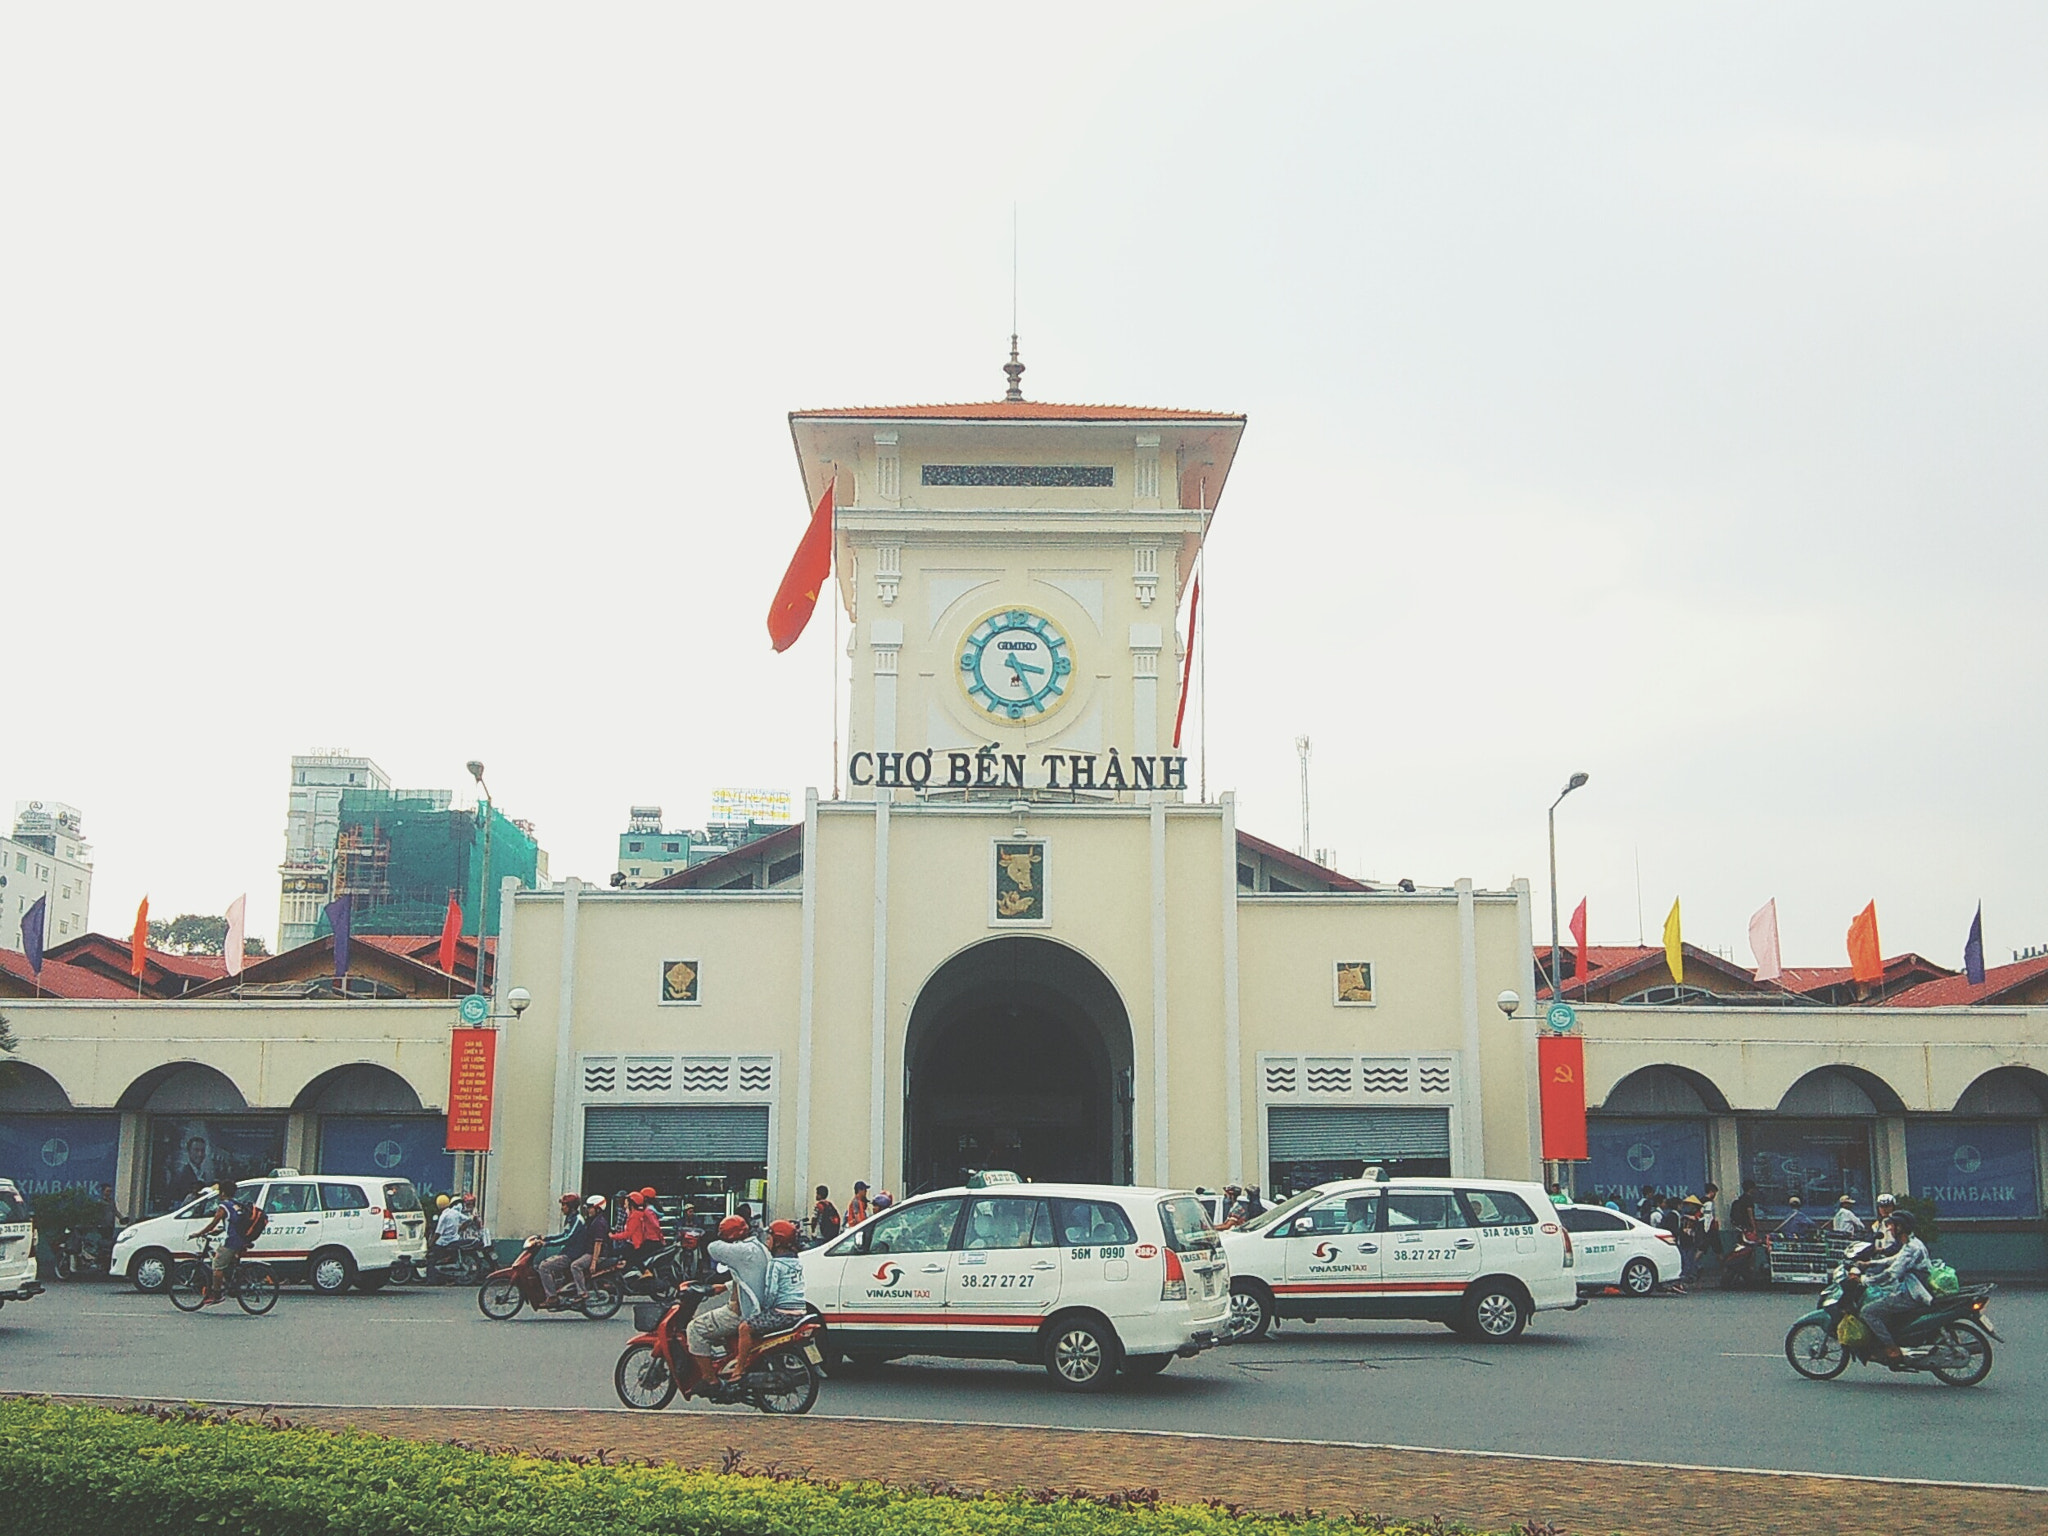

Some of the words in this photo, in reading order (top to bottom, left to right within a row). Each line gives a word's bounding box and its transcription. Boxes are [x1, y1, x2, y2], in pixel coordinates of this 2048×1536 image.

[1006, 611, 1029, 627] 12
[997, 641, 1037, 651] GIMIKO
[961, 653, 976, 670] 9
[1055, 657, 1071, 675] 3
[1007, 702, 1023, 719] 6
[850, 748, 933, 791] CHỢ
[948, 742, 1026, 787] BẾN
[1042, 748, 1187, 789] THÀNH
[16, 1180, 101, 1195] XIMBANK
[1594, 1184, 1688, 1200] EXIMANK
[296, 1226, 306, 1234] 27
[1482, 1228, 1500, 1238] 51A
[1503, 1227, 1520, 1237] 246
[1522, 1226, 1534, 1235] 50
[1071, 1247, 1091, 1260] 56M
[1099, 1246, 1125, 1259] 0990
[1394, 1250, 1424, 1261] 38.27
[1427, 1250, 1440, 1260] 27
[1444, 1249, 1457, 1260] 27
[1309, 1265, 1352, 1273] VINASUN
[961, 1275, 997, 1288] 38.27
[1000, 1275, 1016, 1287] 27
[1019, 1275, 1035, 1287] 27
[866, 1289, 913, 1298] VINASUN
[914, 1289, 931, 1298] TAXI
